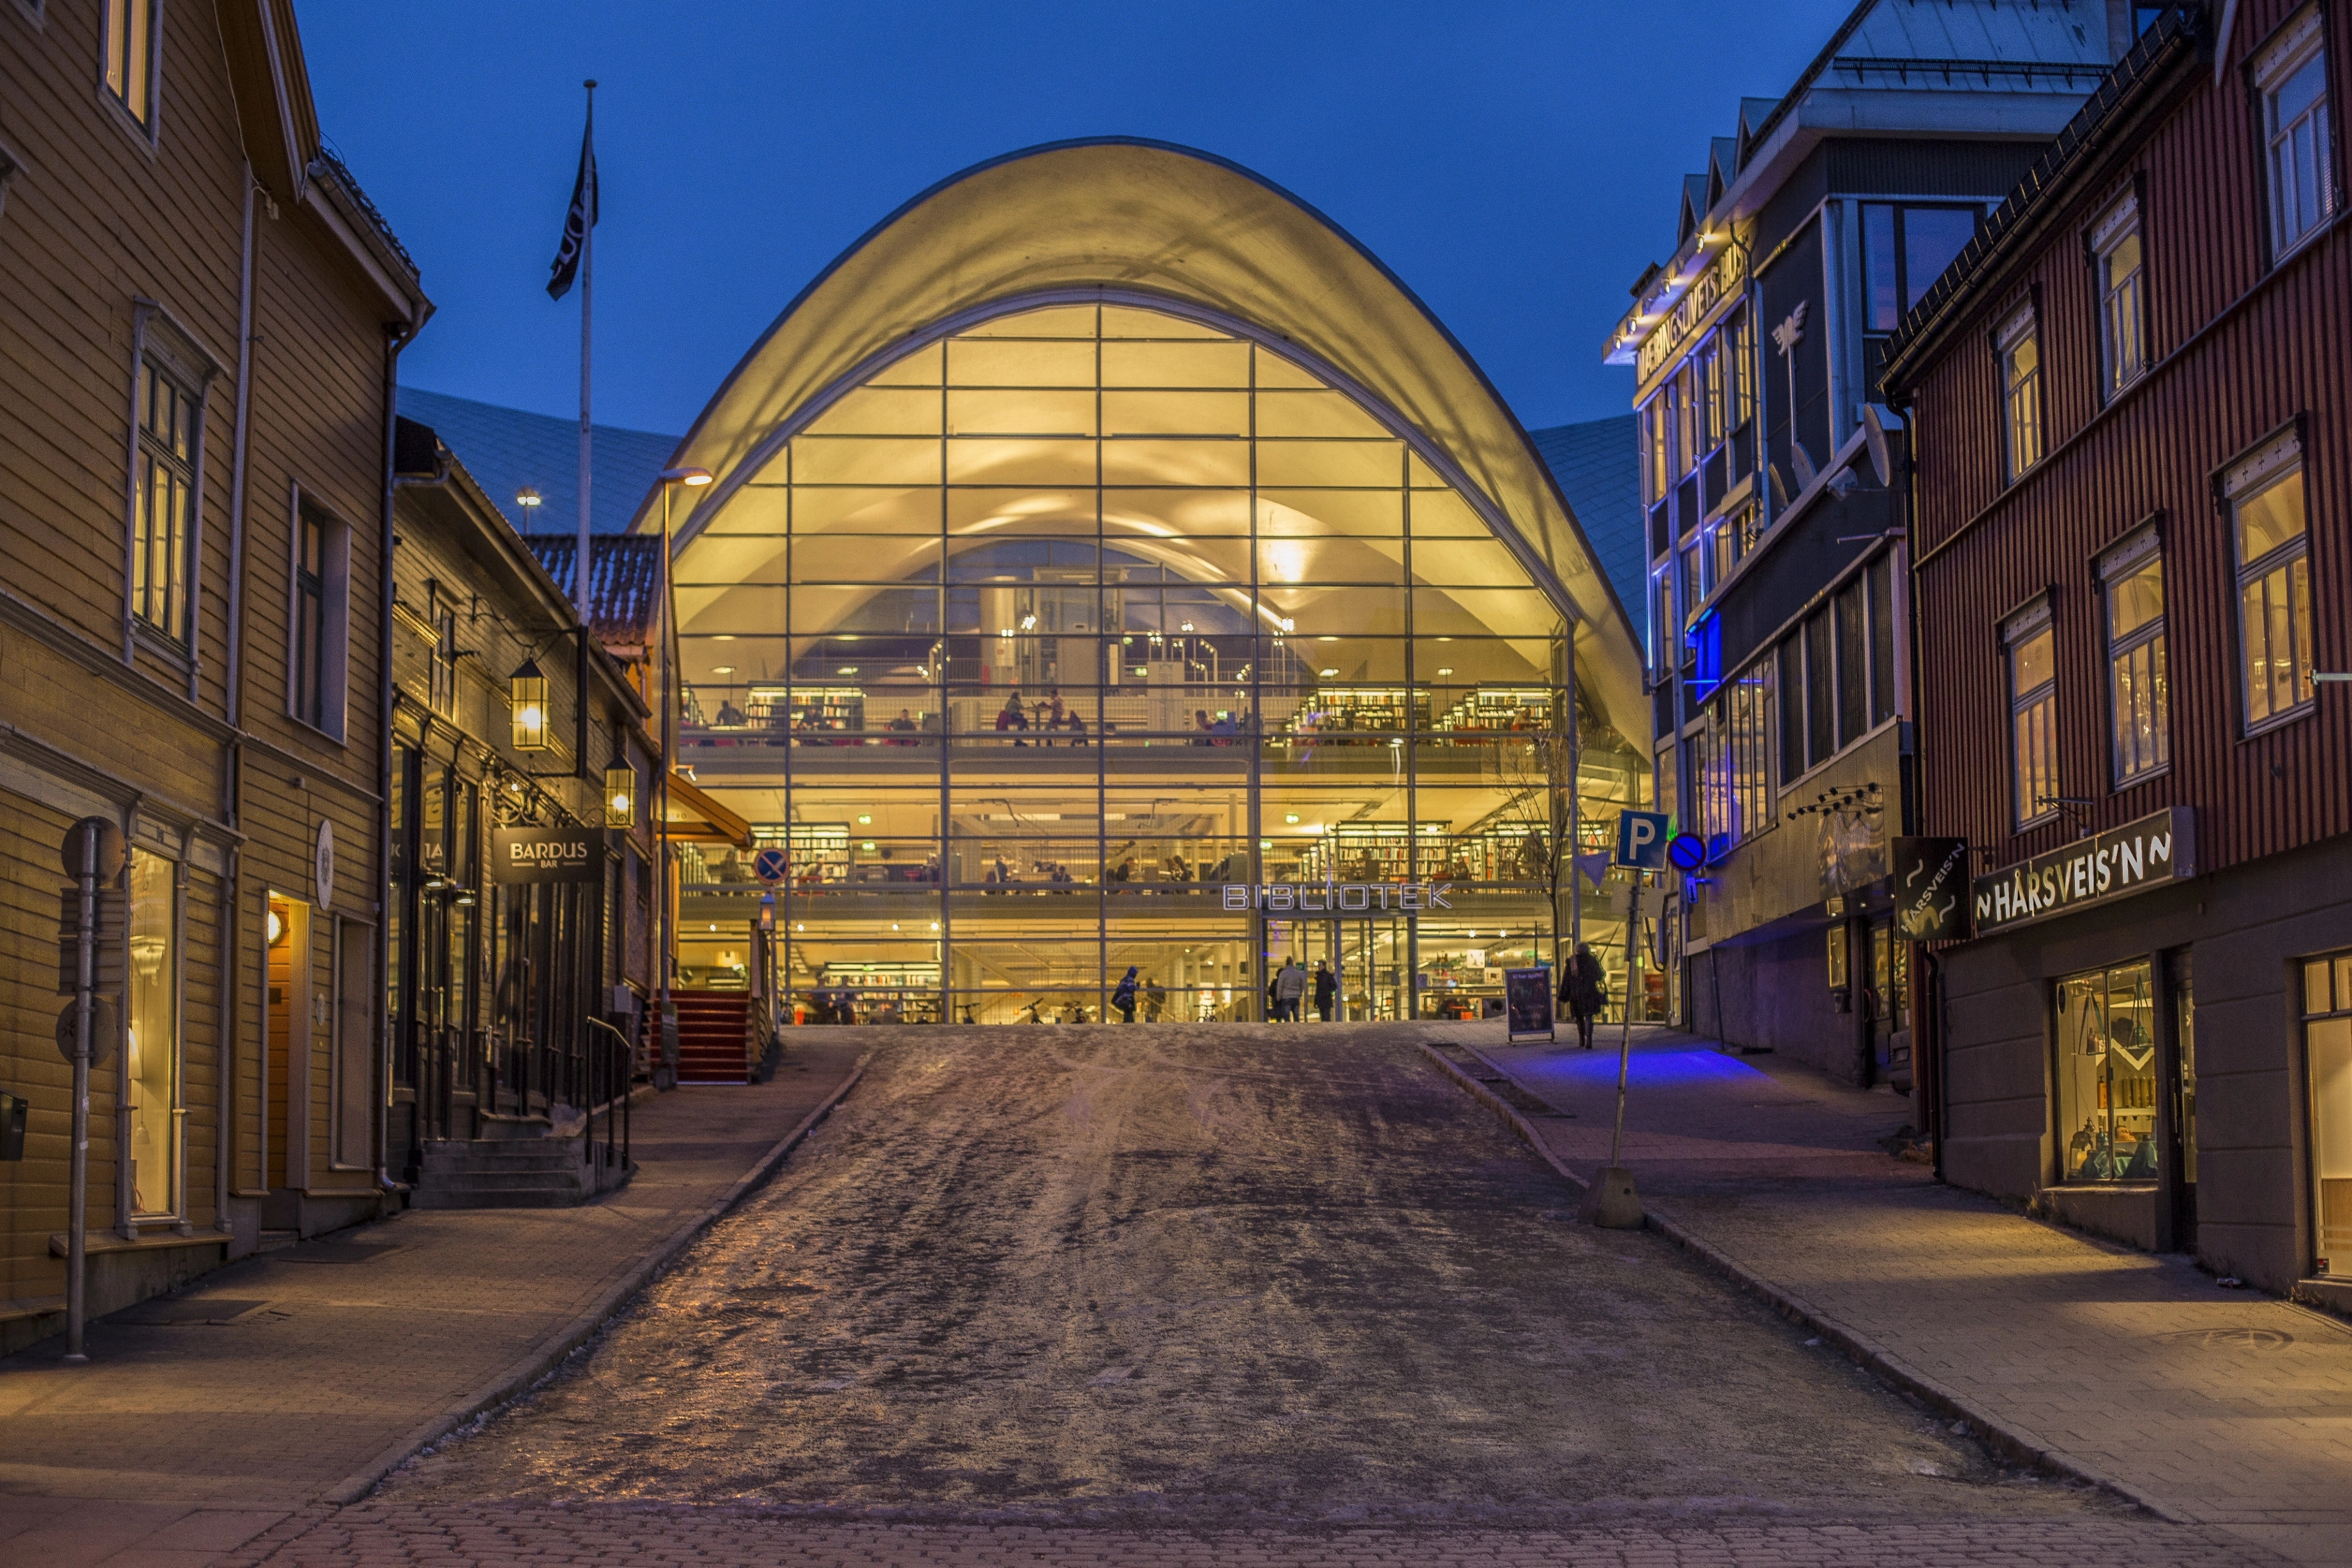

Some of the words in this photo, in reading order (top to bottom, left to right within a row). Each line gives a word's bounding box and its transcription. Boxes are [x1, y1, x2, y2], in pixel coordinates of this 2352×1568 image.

[1638, 266, 1719, 386] NÆRINGSLIVETS
[1719, 236, 1745, 295] HUS
[510, 842, 587, 859] BARDUS
[1629, 818, 1656, 860] P
[540, 859, 557, 869] BAR
[1223, 883, 1453, 910] BIBLIOTEK
